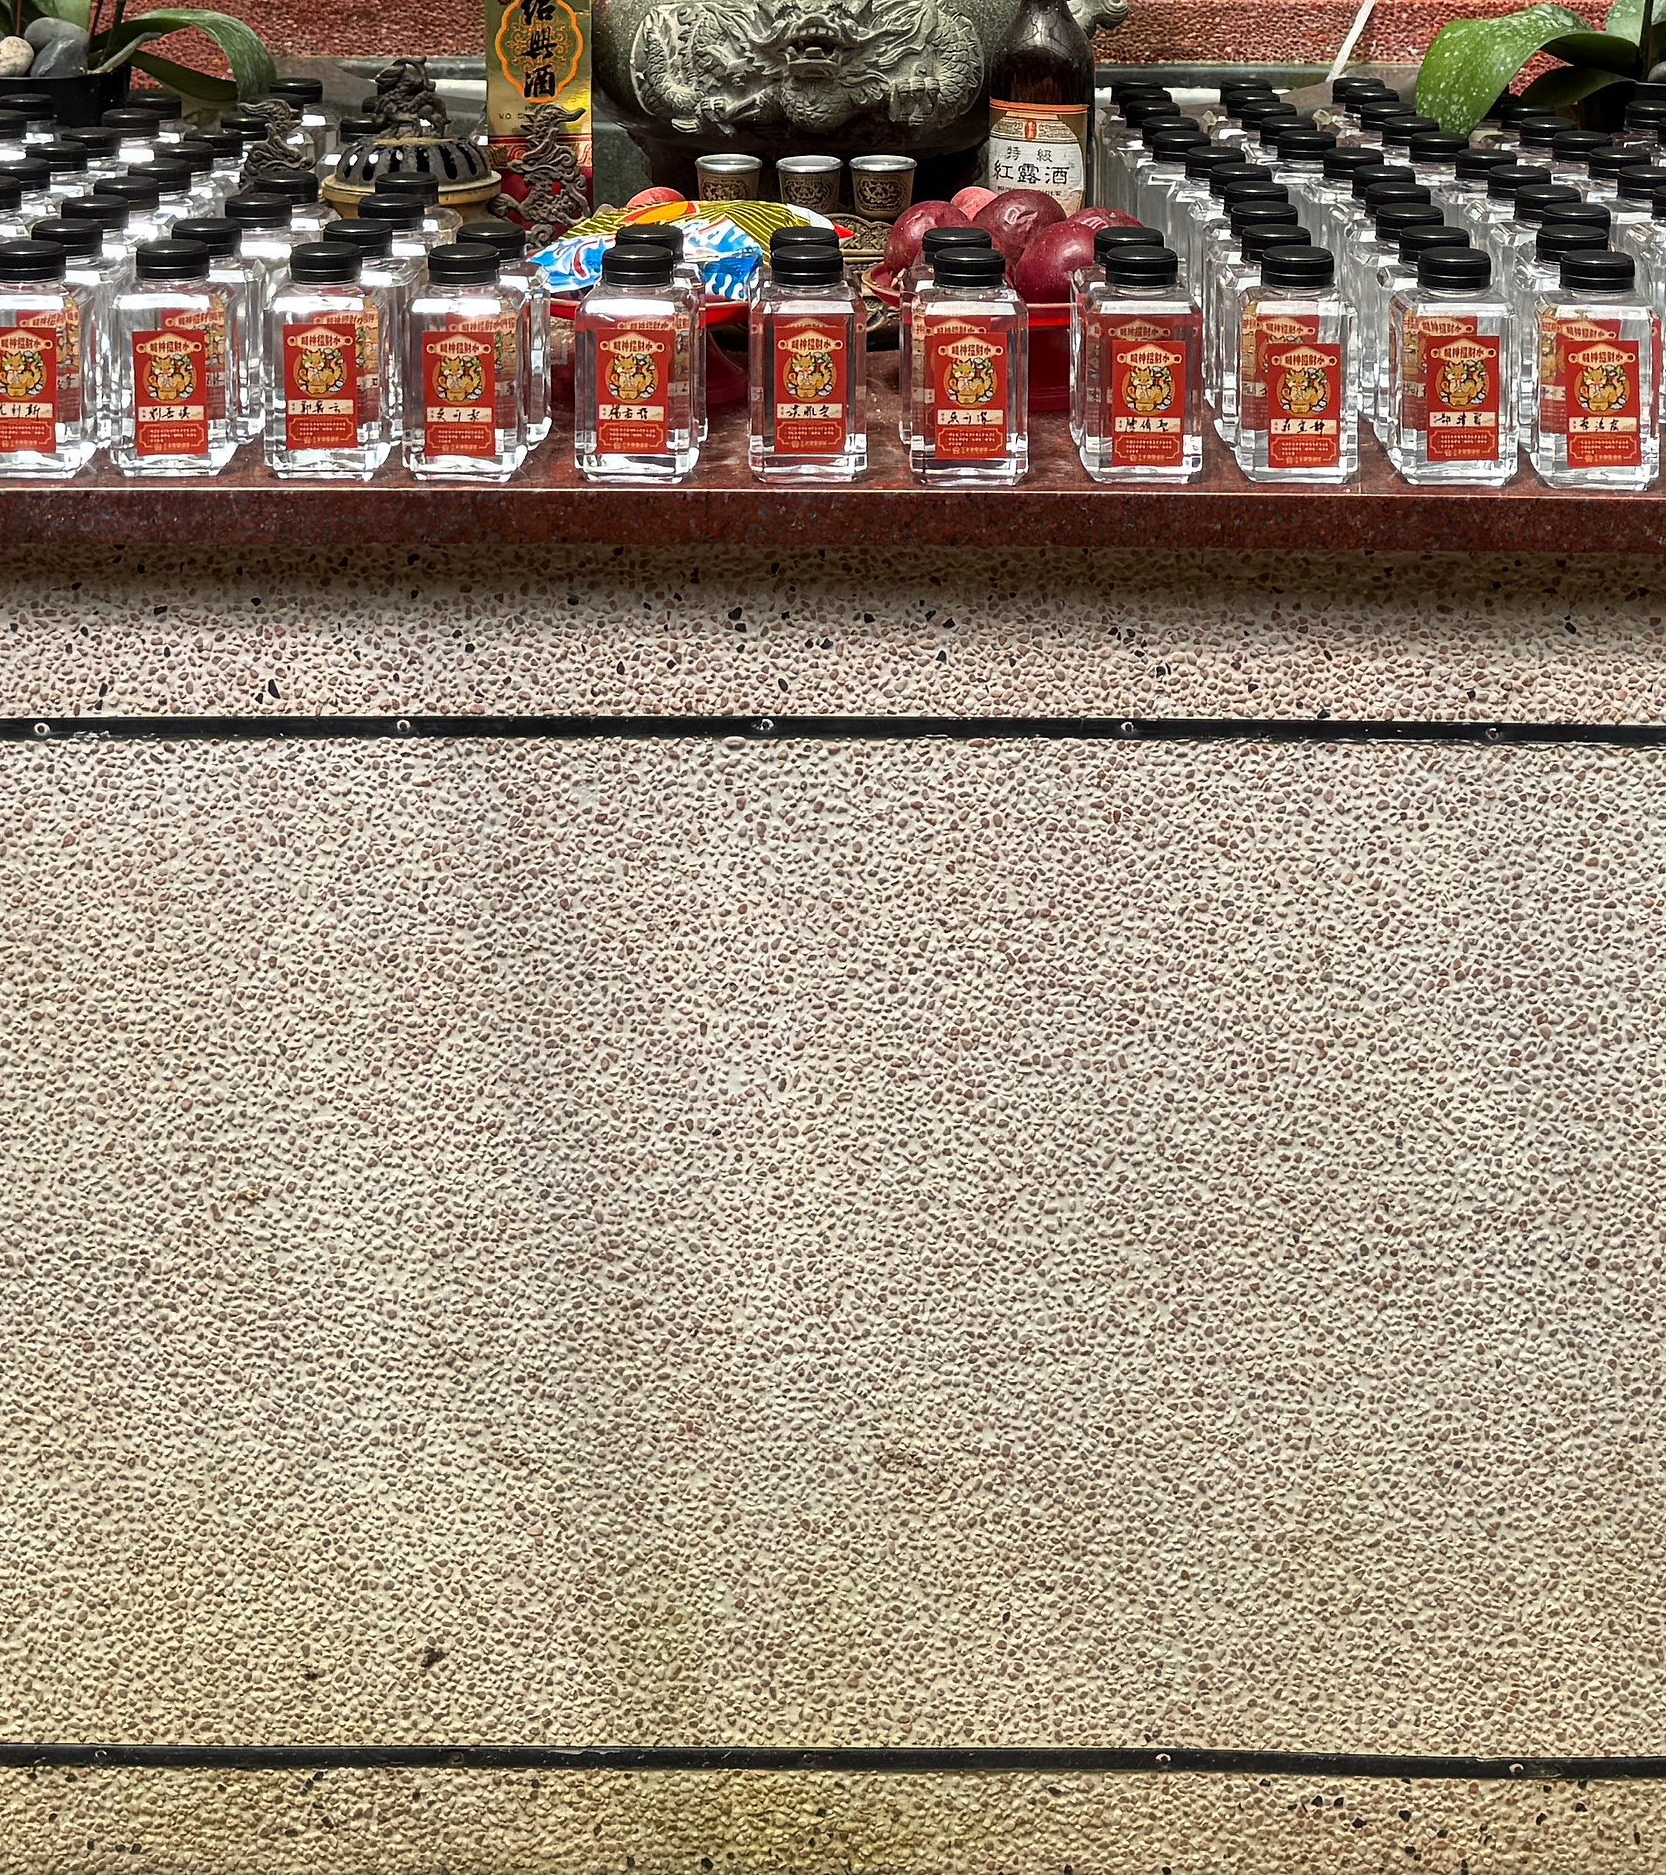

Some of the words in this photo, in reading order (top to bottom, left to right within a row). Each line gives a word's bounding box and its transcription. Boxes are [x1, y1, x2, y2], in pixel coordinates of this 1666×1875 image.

[1006, 146, 1052, 162] 特級
[993, 160, 1070, 185] 紅露酒
